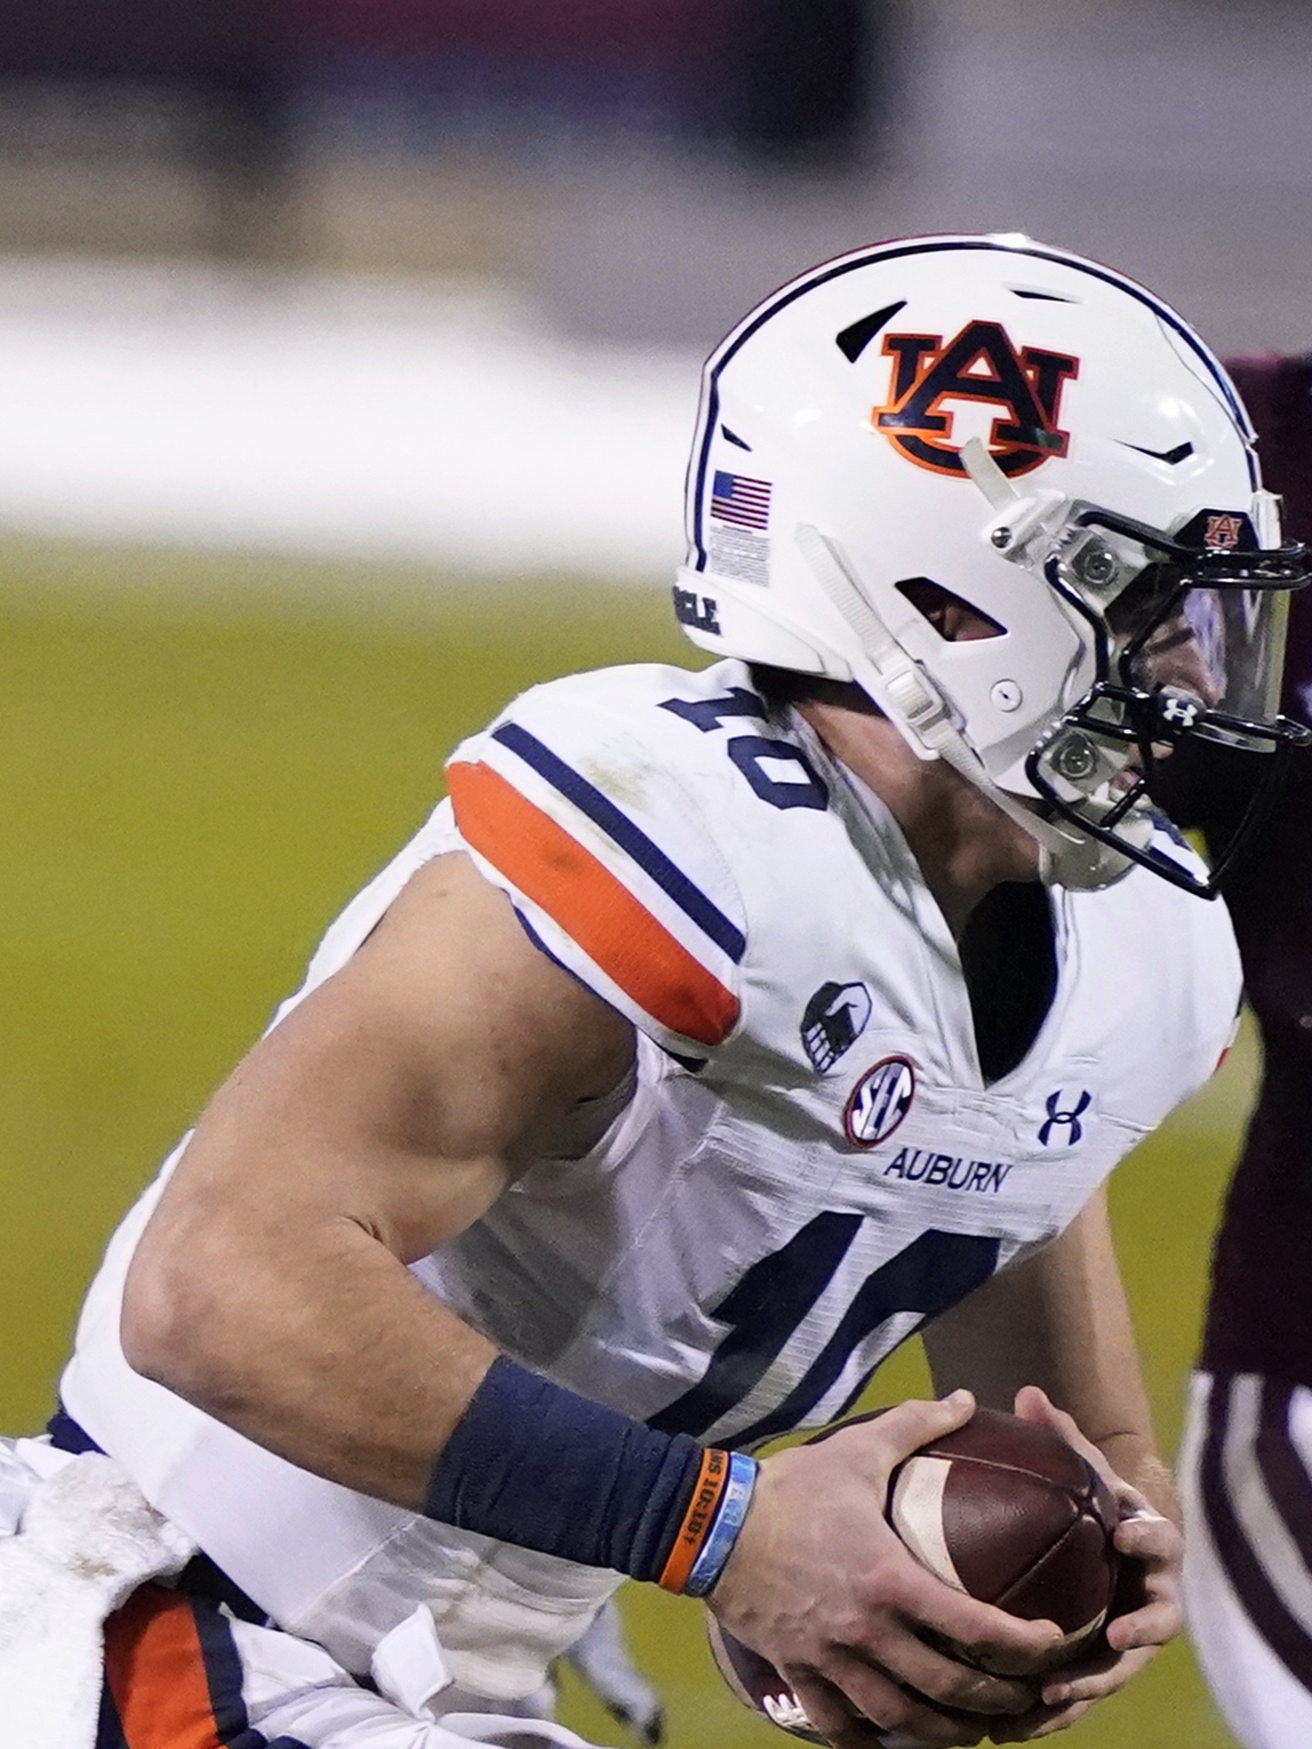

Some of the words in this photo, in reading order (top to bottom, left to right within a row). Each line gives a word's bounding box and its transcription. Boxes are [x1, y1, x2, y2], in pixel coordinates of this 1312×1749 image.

[655, 686, 830, 813] 10
[851, 1061, 914, 1140] SEC
[883, 1147, 1014, 1193] AUBURN
[645, 1210, 1002, 1449] 10
